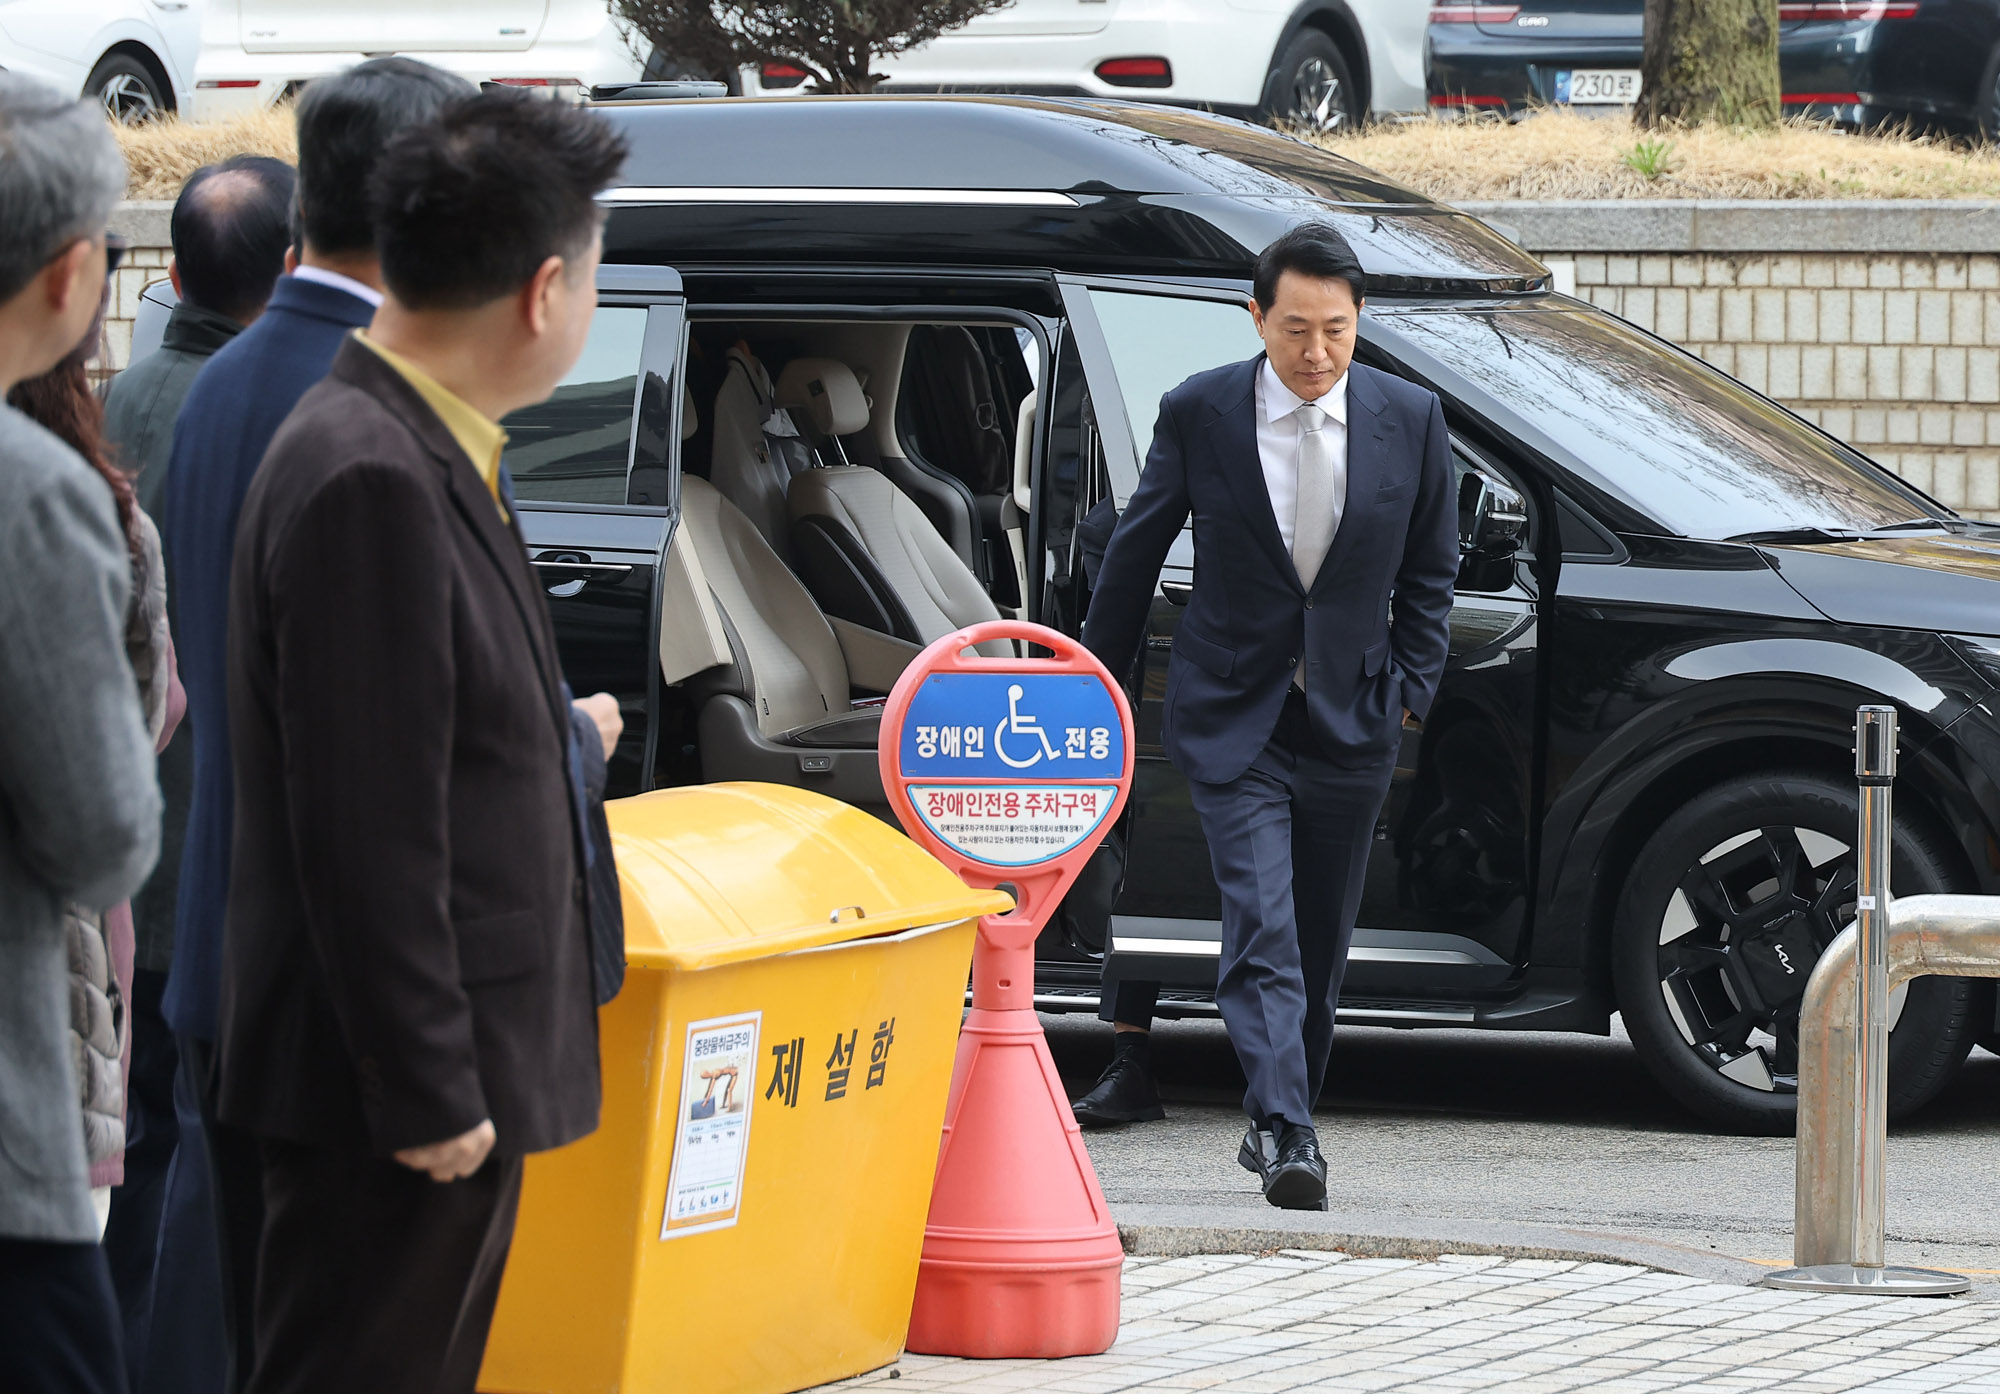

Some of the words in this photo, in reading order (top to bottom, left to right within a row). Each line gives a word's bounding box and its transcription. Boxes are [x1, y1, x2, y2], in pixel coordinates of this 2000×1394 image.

[915, 726, 985, 759] 장애인
[1064, 727, 1111, 761] 전용
[928, 792, 1020, 818] 장애인전용
[1025, 792, 1097, 818] 주차구역
[694, 1031, 750, 1057] 중량물취급주의
